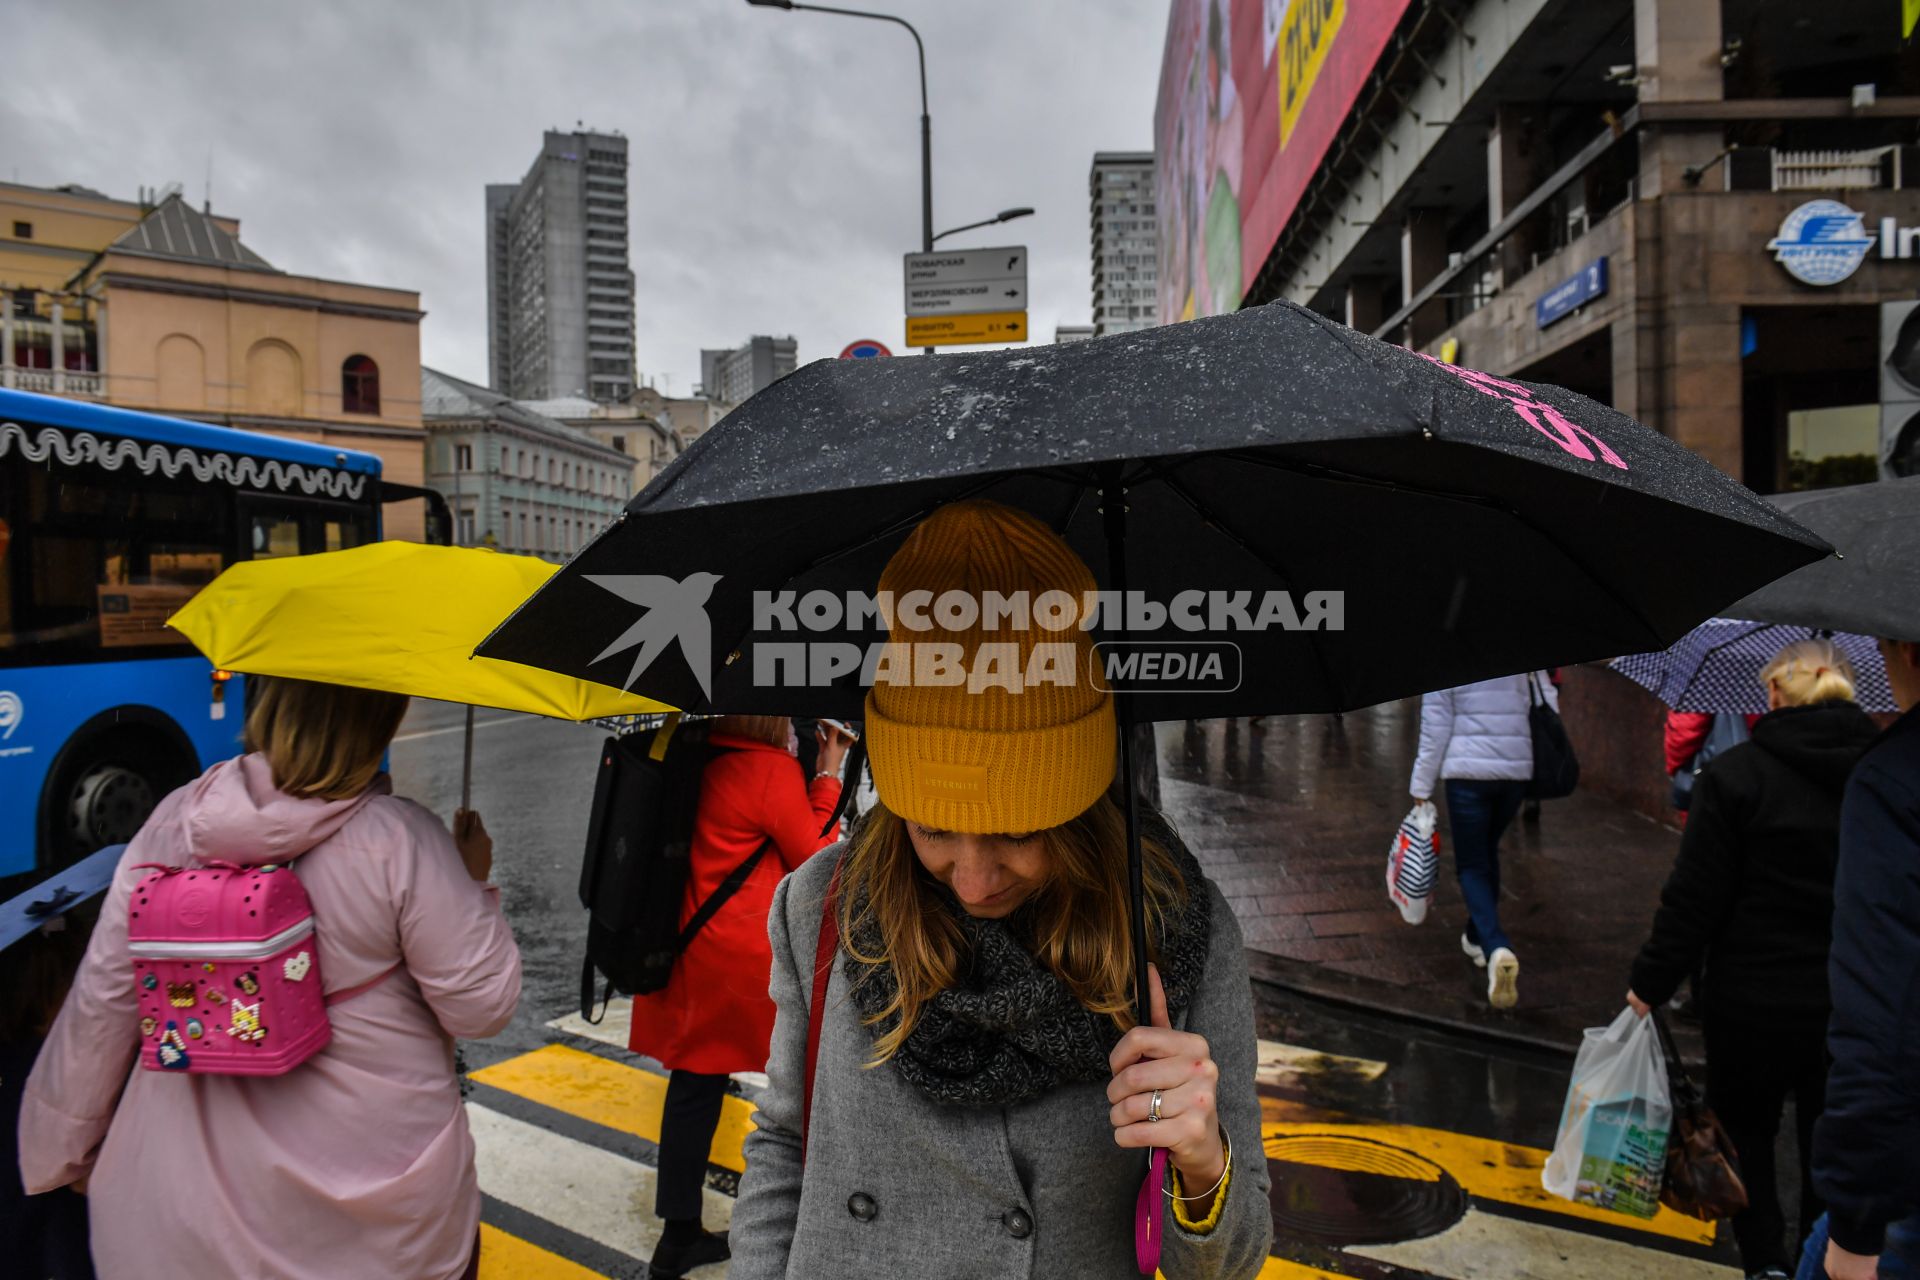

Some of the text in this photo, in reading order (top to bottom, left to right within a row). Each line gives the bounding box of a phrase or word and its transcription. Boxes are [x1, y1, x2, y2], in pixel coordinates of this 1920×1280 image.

[911, 257, 965, 269] ПОВАРСКАЯ
[911, 270, 937, 280] улица
[1588, 266, 1598, 291] 2
[911, 285, 989, 298] МЕРЗЛЯКОВСКИЙ
[911, 298, 951, 309] переулок
